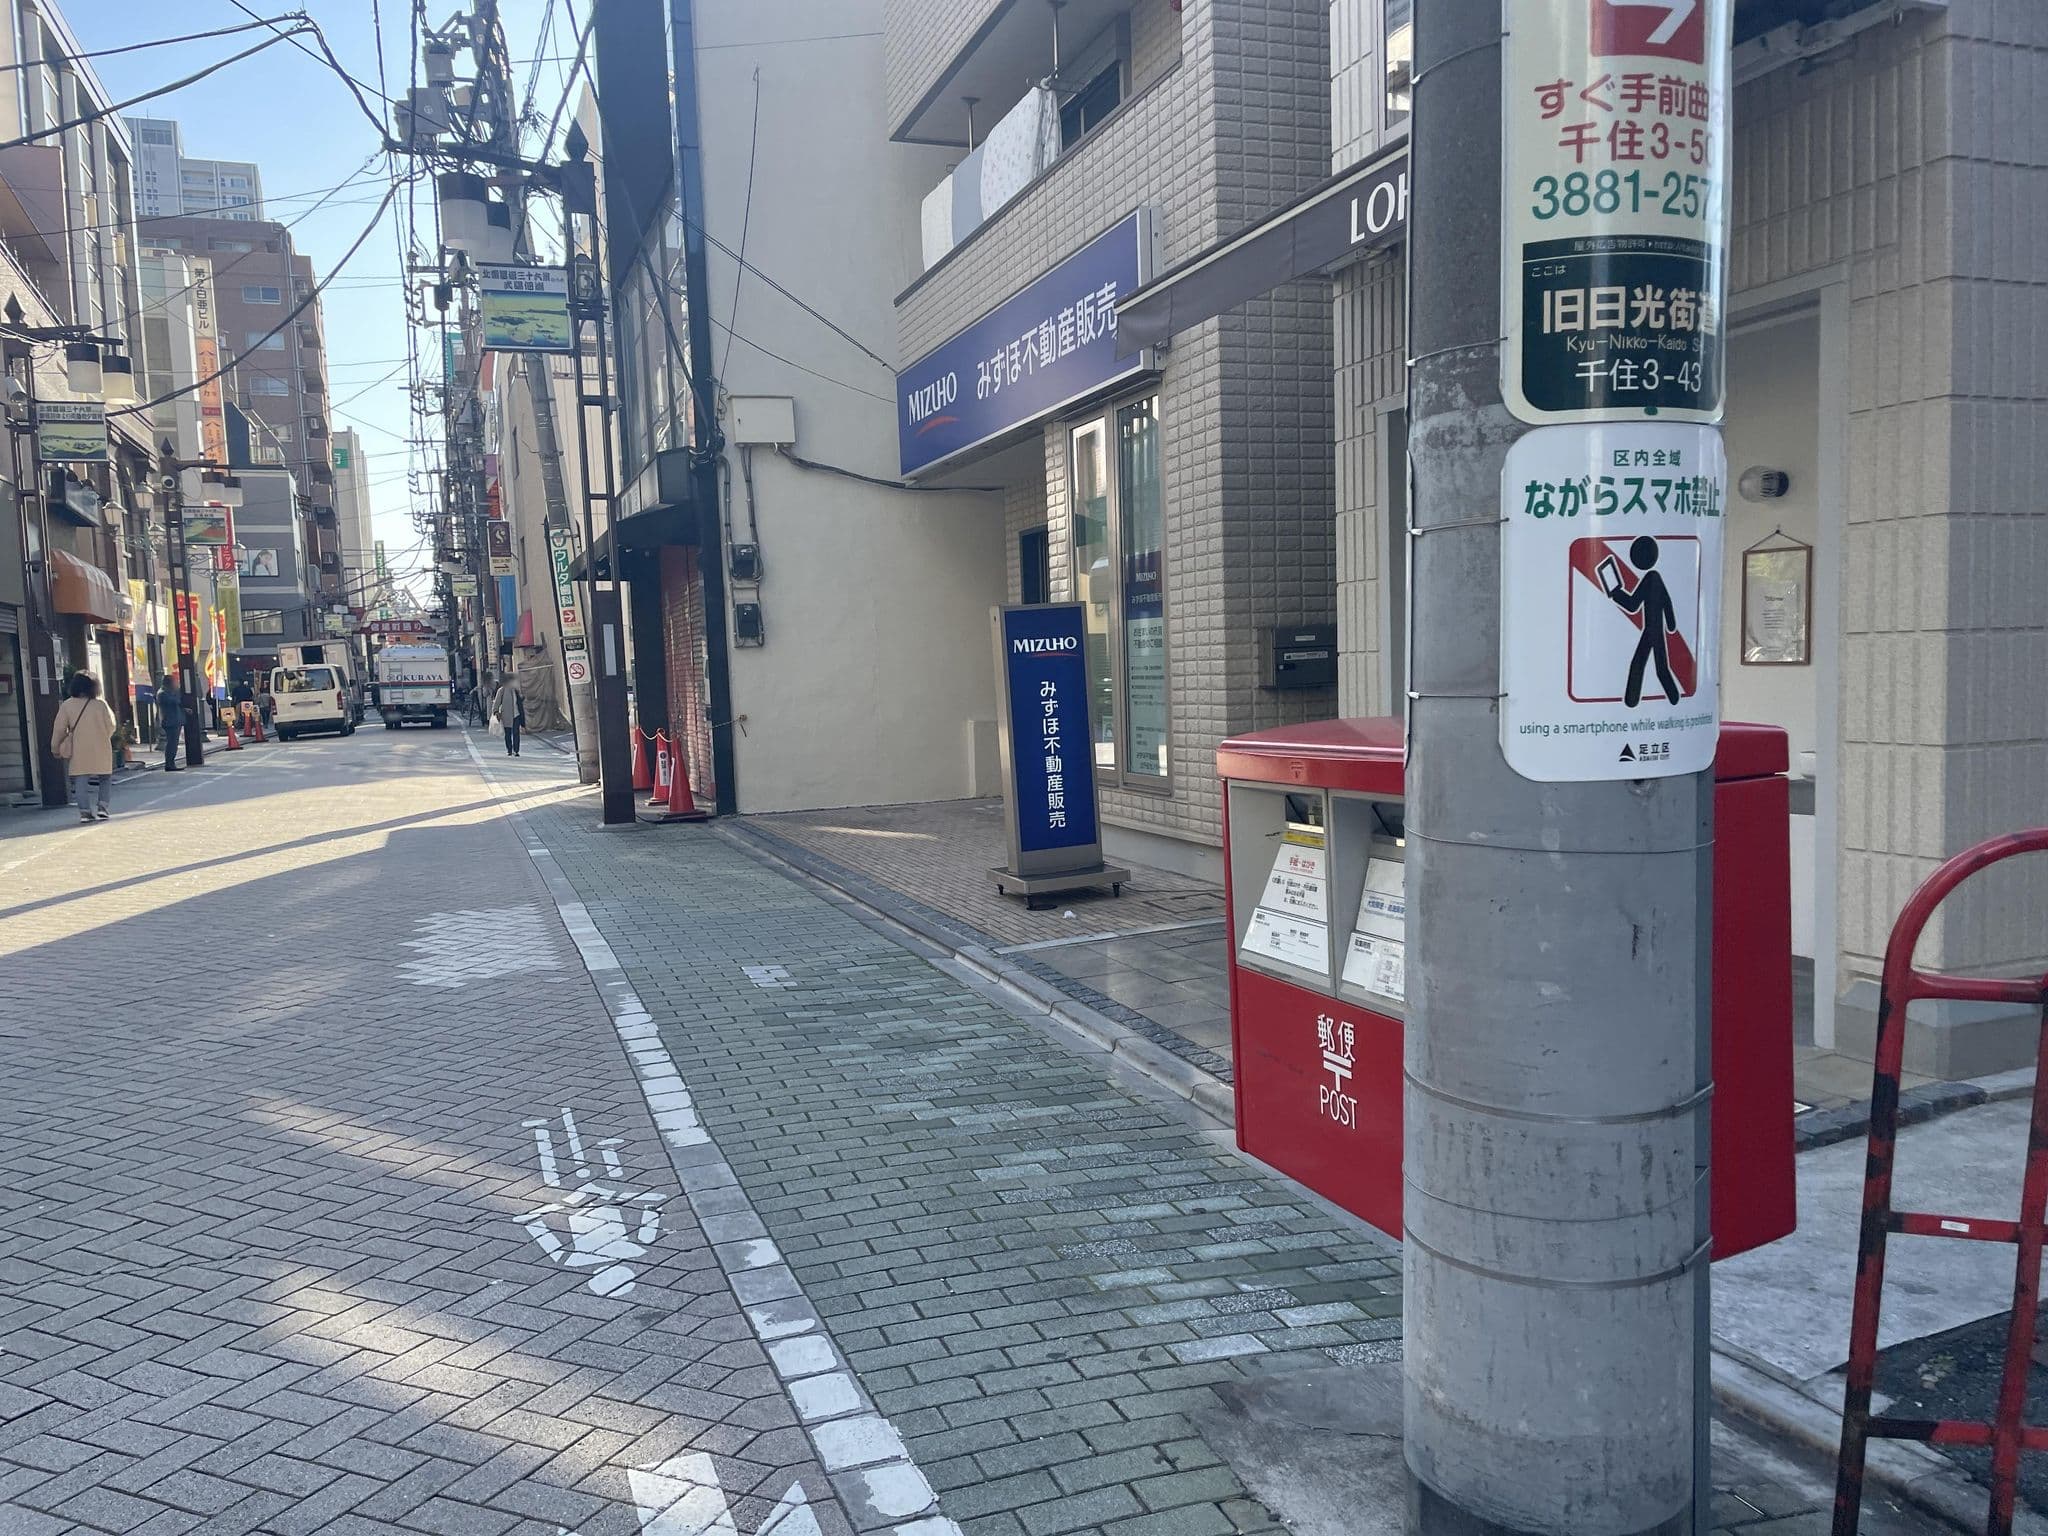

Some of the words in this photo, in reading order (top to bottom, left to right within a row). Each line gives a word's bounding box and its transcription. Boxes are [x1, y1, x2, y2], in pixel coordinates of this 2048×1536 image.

[1534, 73, 1713, 122] すぐ手前曲
[1531, 169, 1716, 222] 3881-257
[1531, 264, 1567, 278] ここは
[975, 280, 1118, 401] みずほ不動産販売
[1575, 358, 1703, 393] 千住3-43
[908, 371, 958, 426] MIZUHO
[1613, 449, 1682, 468] 区内全域
[1524, 474, 1721, 519] ながらスマホ禁止
[1013, 636, 1078, 654] MIZUHO
[1519, 722, 1550, 738] using
[1553, 724, 1560, 734] a
[1563, 719, 1629, 736] smartphone
[1631, 717, 1655, 732] while
[1658, 716, 1685, 731] walking
[1639, 741, 1671, 755] 足立区
[1040, 680, 1067, 829] みずほ不動産販売
[1316, 1013, 1356, 1063] 郵便
[1319, 1084, 1358, 1130] POST
